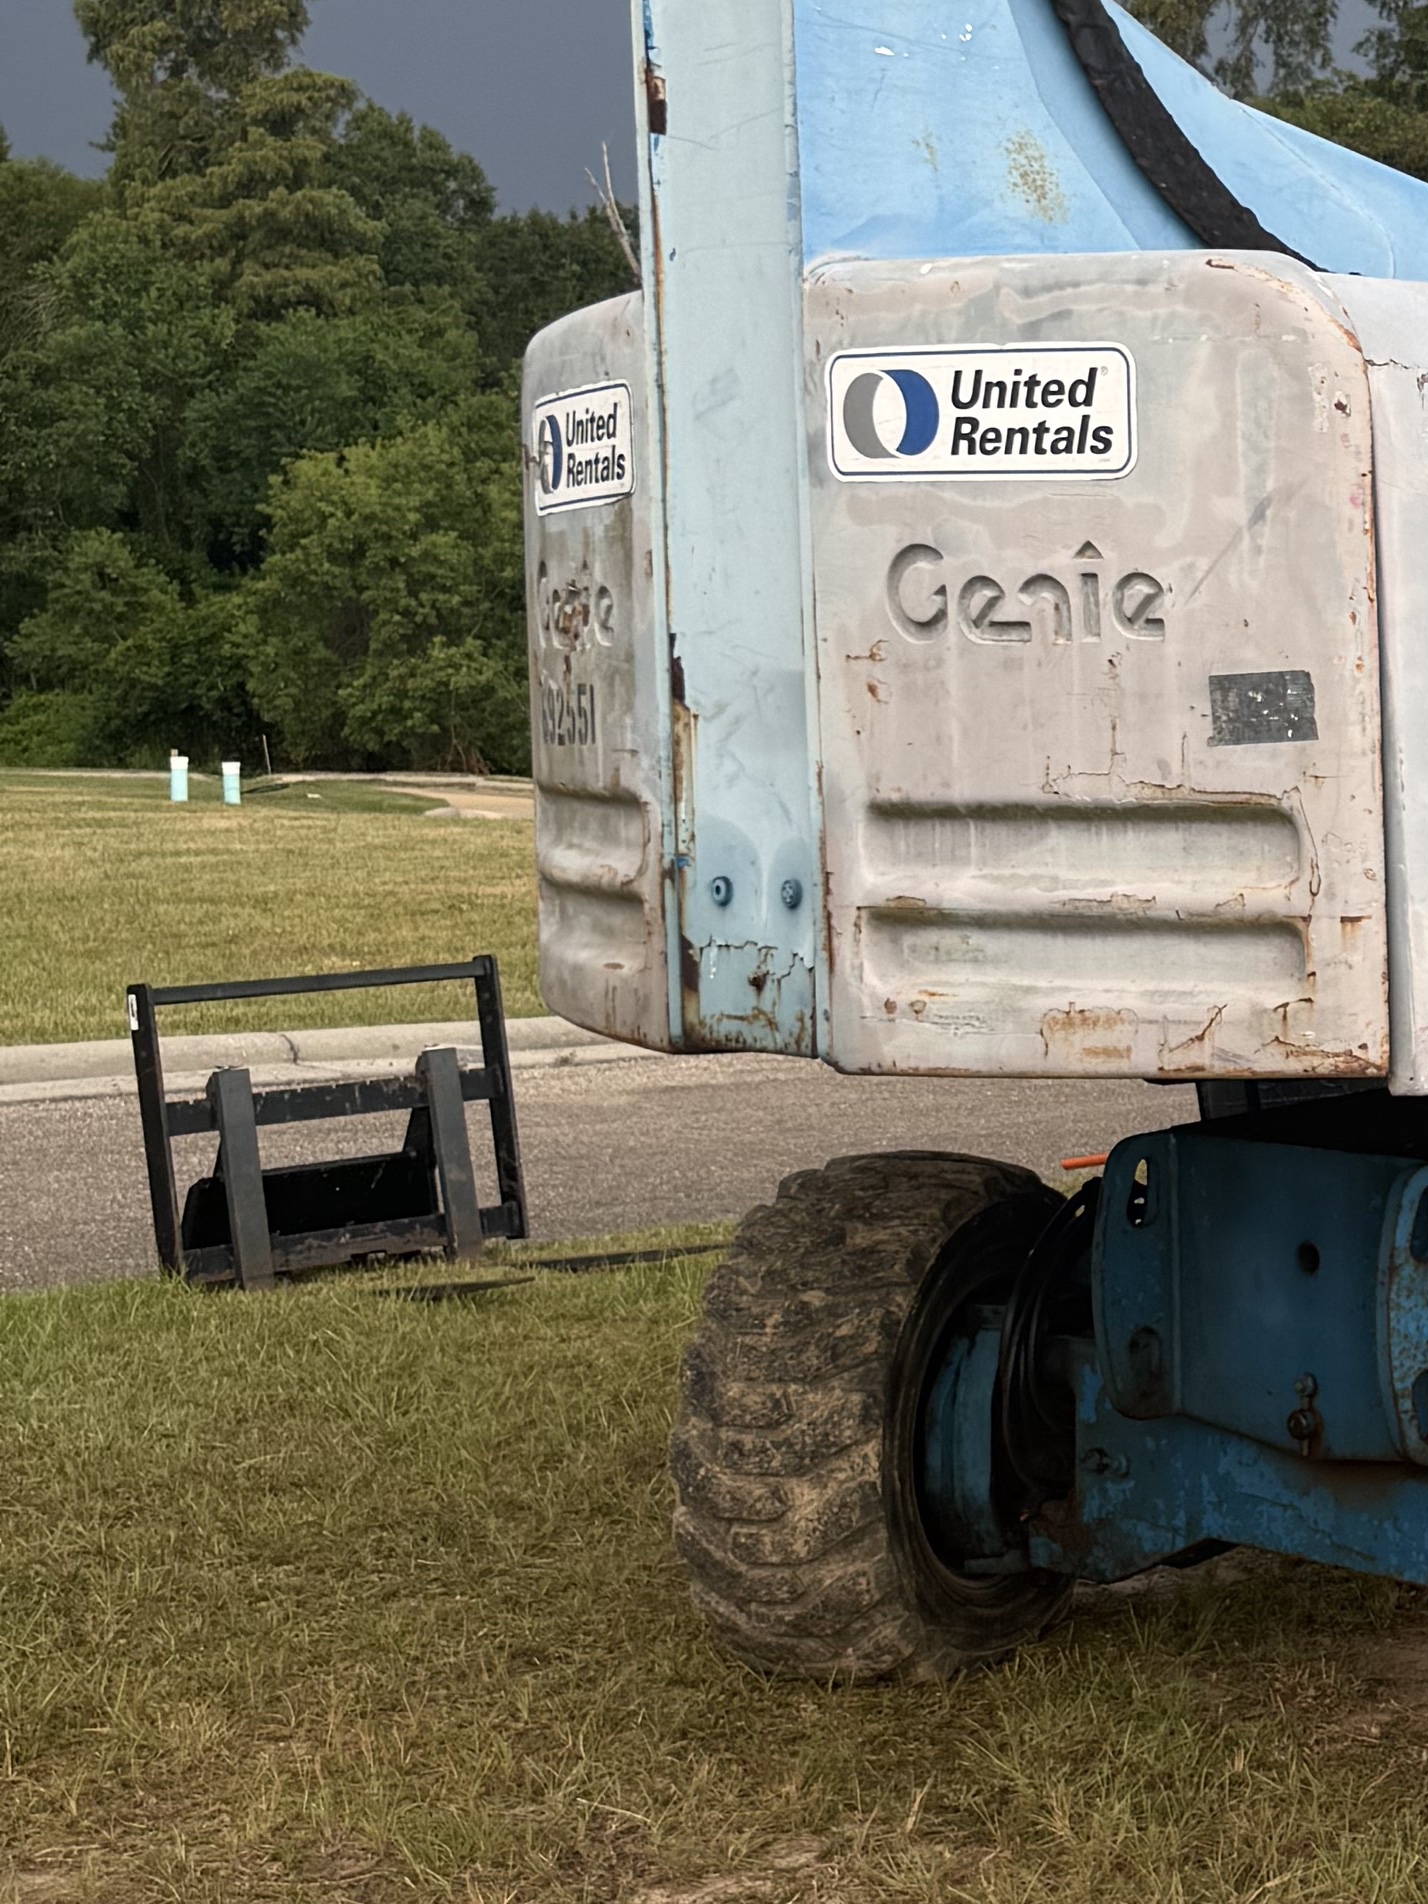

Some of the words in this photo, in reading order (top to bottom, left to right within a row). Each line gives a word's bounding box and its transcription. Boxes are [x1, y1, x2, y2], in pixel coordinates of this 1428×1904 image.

[952, 367, 1098, 410] United
[566, 402, 618, 447] United
[951, 415, 1114, 456] Rentals
[567, 444, 626, 488] Rentals
[887, 540, 1166, 645] Genie
